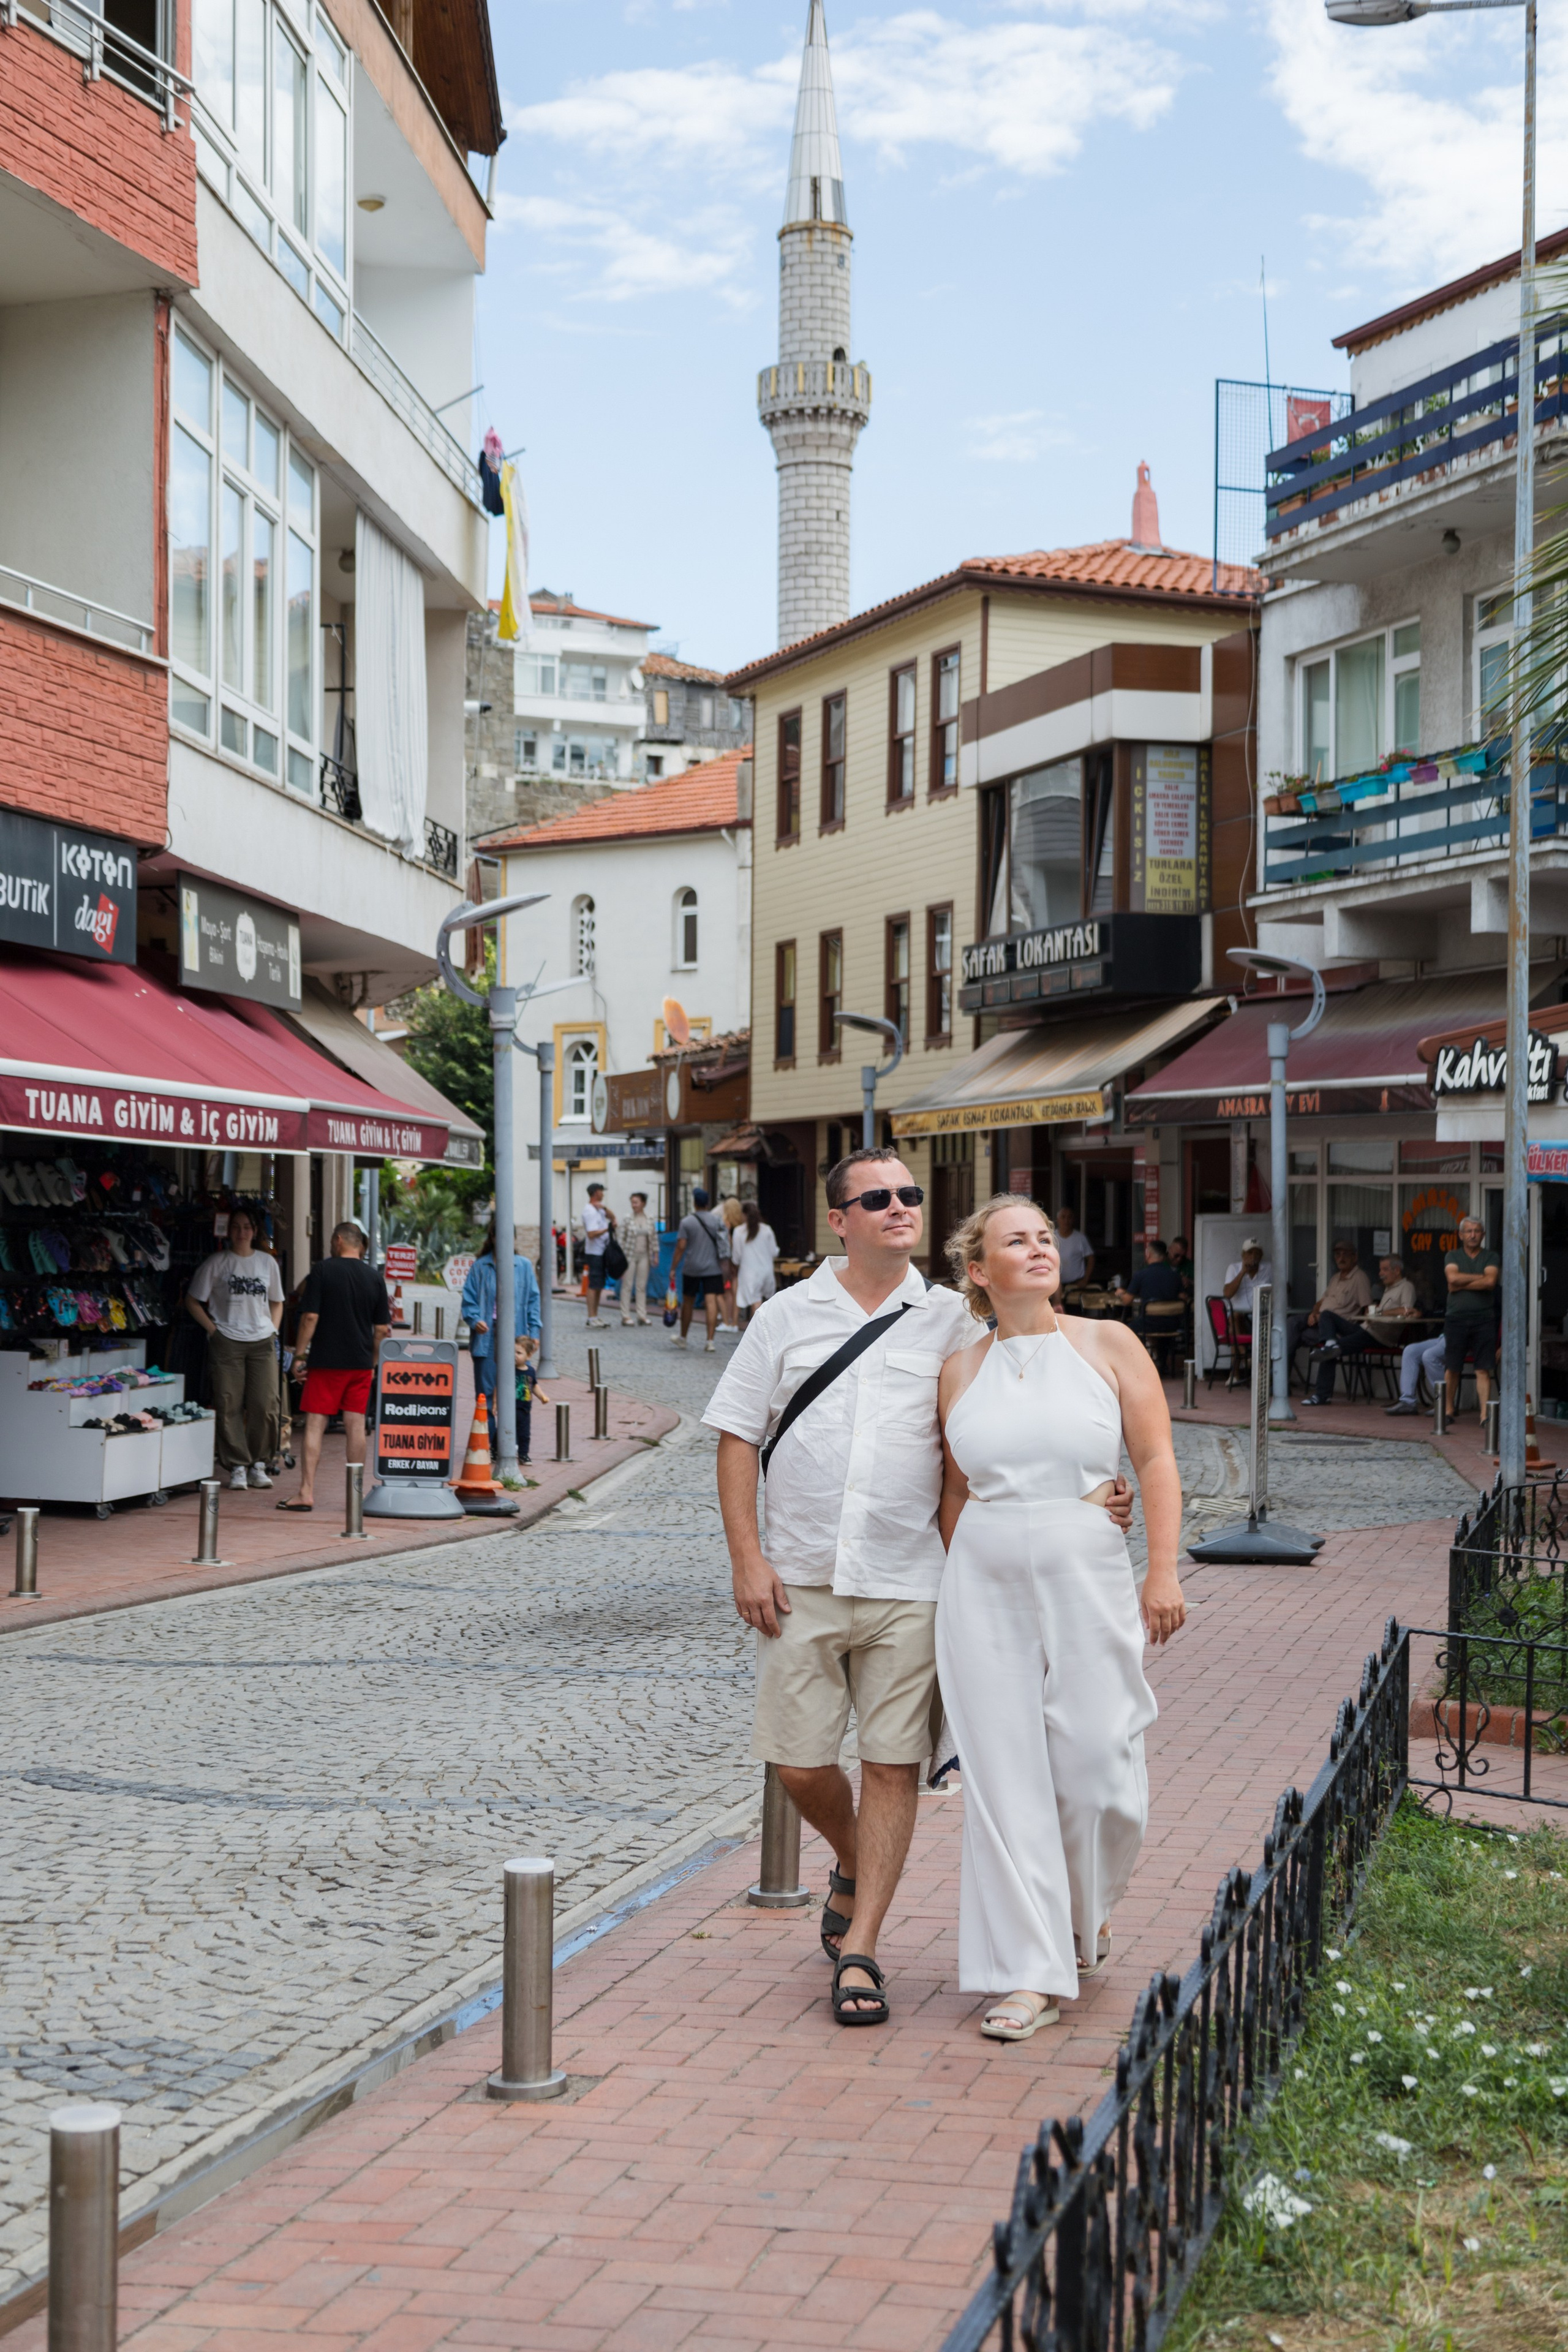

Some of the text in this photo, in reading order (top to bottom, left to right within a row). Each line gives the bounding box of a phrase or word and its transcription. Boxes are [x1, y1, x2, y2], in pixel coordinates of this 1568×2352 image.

[1159, 872, 1183, 884] ÖZEL
[1017, 922, 1099, 970] LOKANTASI
[1217, 1096, 1266, 1117] AMASRA
[1298, 1089, 1320, 1113] EVİ
[25, 1088, 278, 1144] TUANA GİYİM & İÇ GİYİM
[328, 1118, 356, 1145] TUANA
[360, 1120, 383, 1148] GİYİM
[385, 1128, 391, 1148] &
[392, 1123, 400, 1156] İÇ
[401, 1126, 422, 1152] GİYİM
[1528, 1144, 1568, 1175] ÜLKER
[383, 1433, 445, 1451] TUANA GİYİM
[388, 1459, 410, 1469] ERKEK
[417, 1460, 439, 1470] BAYAN
